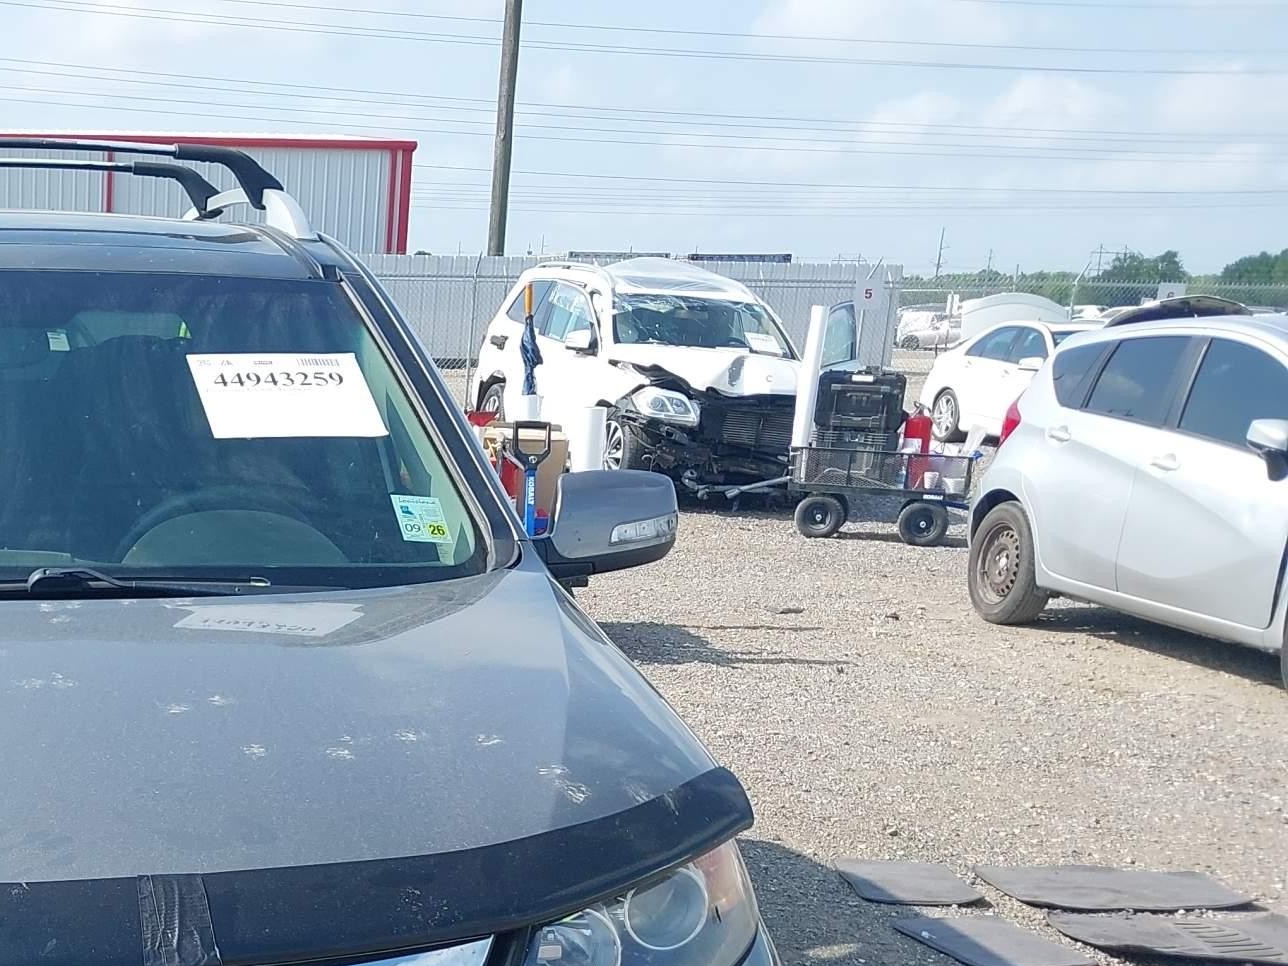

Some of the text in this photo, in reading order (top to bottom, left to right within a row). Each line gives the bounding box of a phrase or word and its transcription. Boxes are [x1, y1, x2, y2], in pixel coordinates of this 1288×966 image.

[864, 288, 873, 300] 5
[214, 372, 344, 387] 44943259
[404, 523, 446, 536] 09 26
